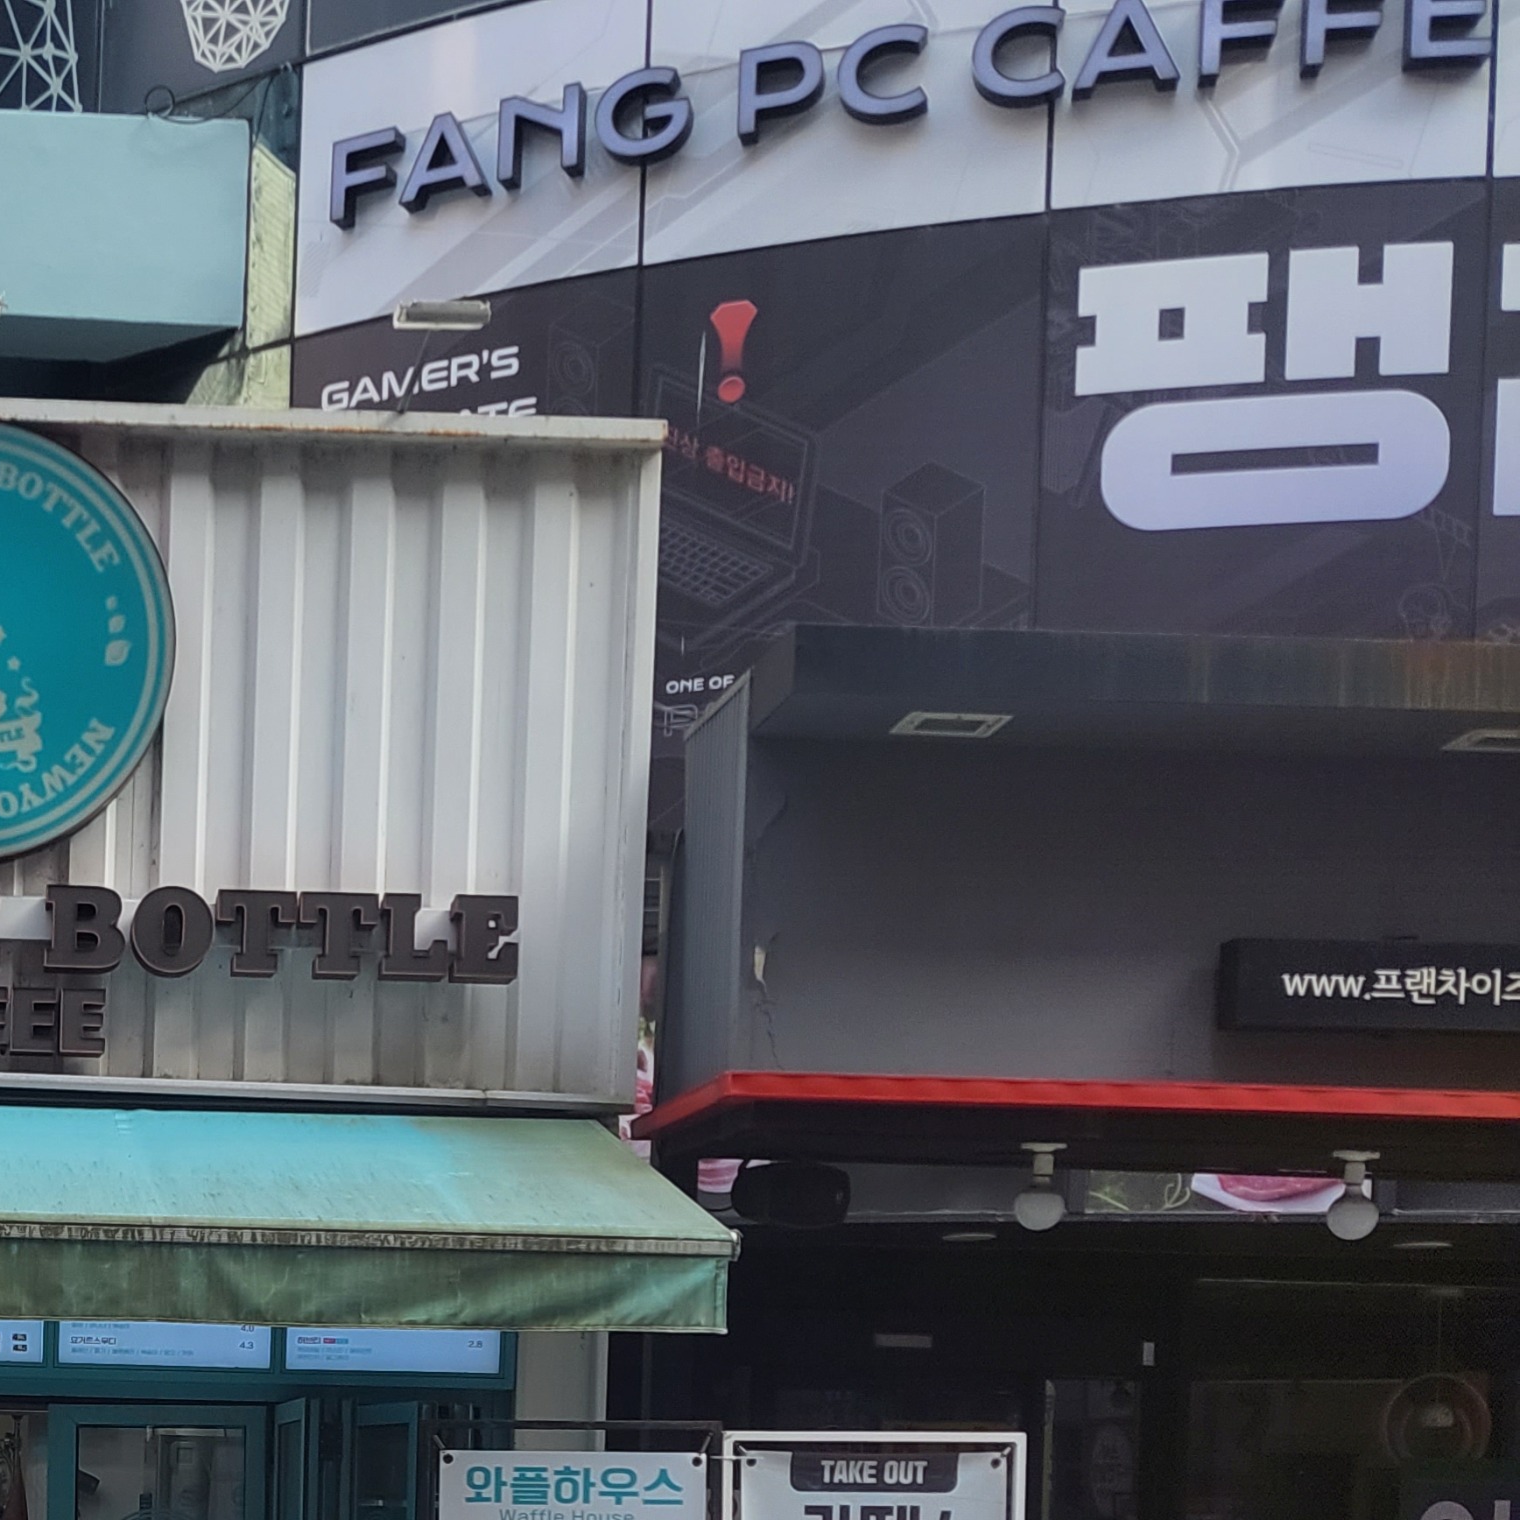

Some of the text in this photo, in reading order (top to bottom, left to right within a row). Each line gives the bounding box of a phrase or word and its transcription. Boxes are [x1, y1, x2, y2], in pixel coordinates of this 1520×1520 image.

[329, 0, 1492, 228] FANG PC CAFFE
[321, 346, 520, 411] GAMER'S
[1075, 241, 1520, 531] 팽
[666, 674, 736, 694] ONE OF
[45, 882, 520, 984] BOTTLE
[239, 1341, 254, 1349] 4.3
[465, 1466, 685, 1506] 와플하우스
[821, 1459, 928, 1485] TAKE OUT
